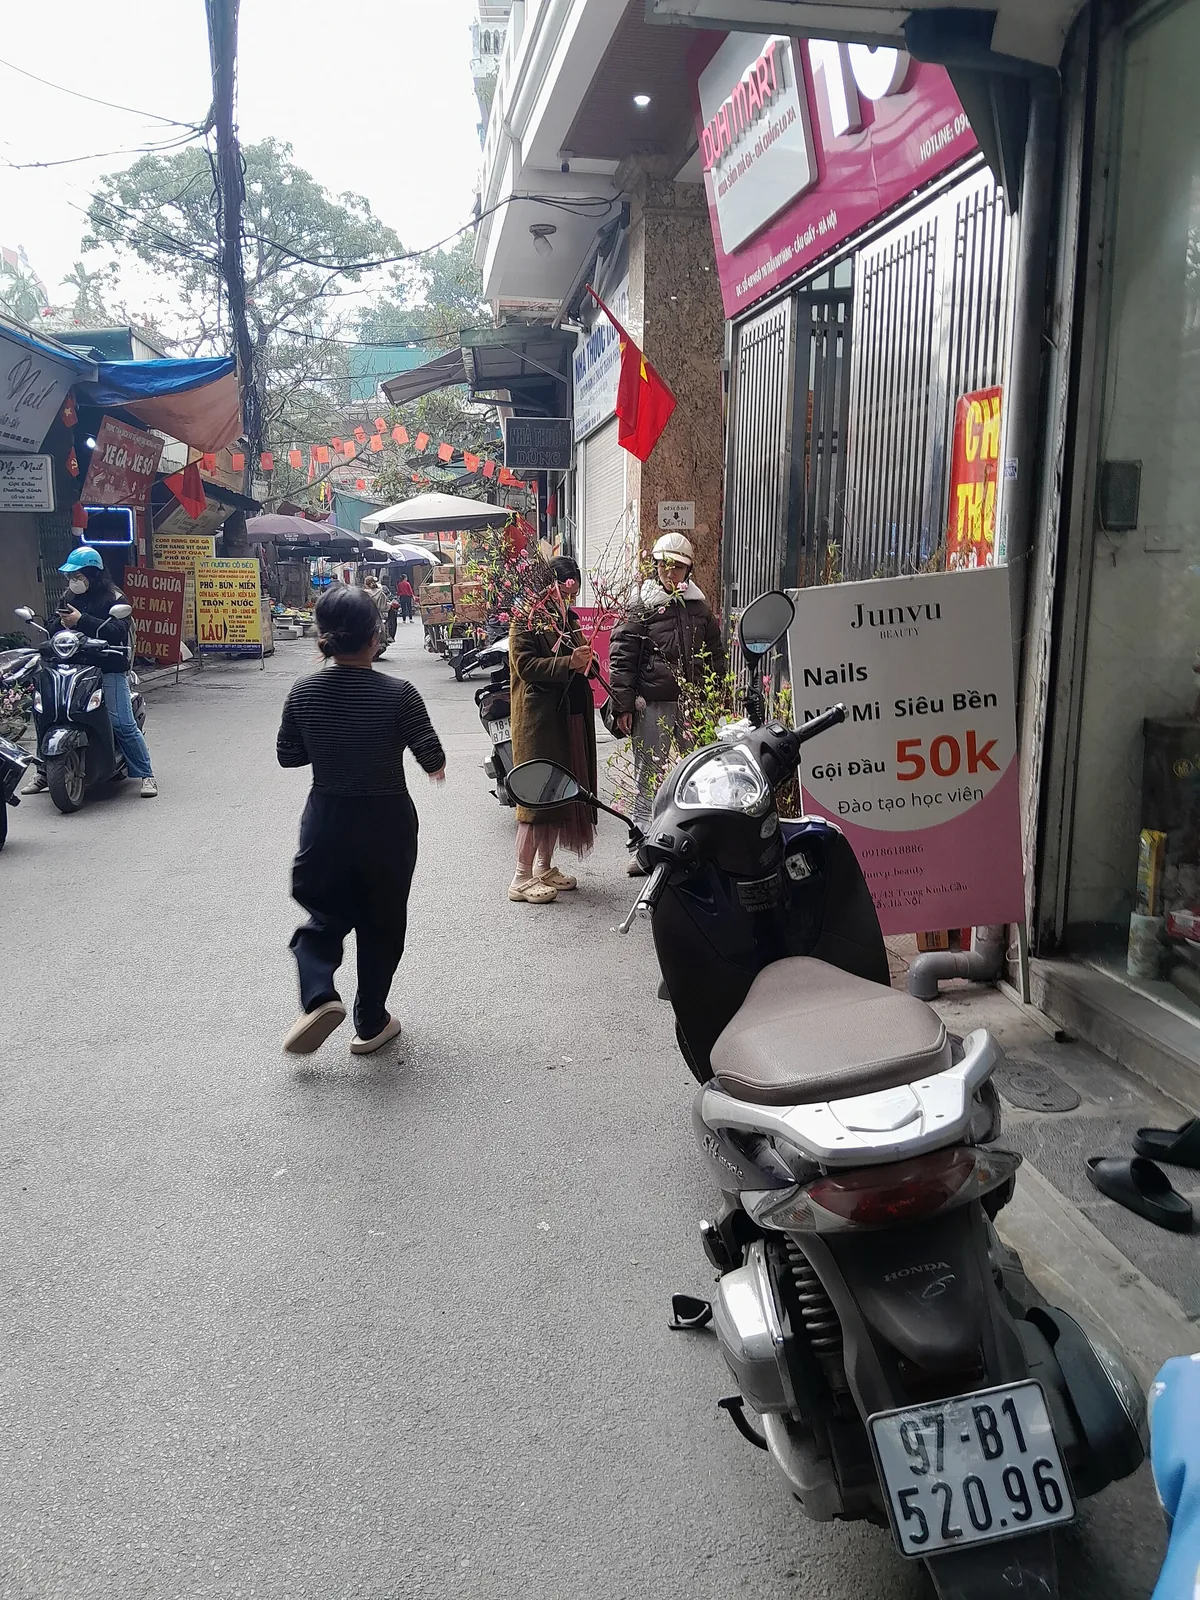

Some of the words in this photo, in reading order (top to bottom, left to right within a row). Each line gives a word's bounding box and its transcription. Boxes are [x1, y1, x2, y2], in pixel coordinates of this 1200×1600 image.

[732, 40, 778, 134] MART
[920, 124, 954, 161] HOTLINE:
[8, 354, 58, 412] Nail
[102, 444, 117, 465] XE
[116, 448, 128, 468] GA
[131, 453, 144, 473] XE
[142, 452, 156, 476] SỐ
[127, 570, 148, 588] SỬA
[152, 576, 182, 592] CHỮA
[200, 579, 214, 588] PHỞ
[219, 580, 234, 589] BÚN
[238, 579, 256, 590] MIẾN
[132, 596, 146, 610] XE
[149, 597, 174, 614] MÁY
[202, 598, 224, 608] TRỘN
[850, 602, 943, 628] Junvu
[154, 618, 177, 636] DẦU
[201, 614, 222, 640] LẨU
[880, 627, 920, 640] BEAUTY
[137, 636, 152, 654] ỬA
[156, 642, 169, 656] XE
[803, 662, 868, 687] Nails
[852, 702, 880, 722] Mi
[894, 696, 944, 717] Siêu
[952, 690, 998, 710] Bền
[812, 762, 842, 782] Gội
[848, 759, 886, 776] Đầu
[896, 730, 1000, 781] 50k
[838, 798, 872, 814] Đào
[878, 796, 906, 812] tạo
[912, 792, 943, 808] học
[948, 786, 984, 802] viên
[897, 888, 924, 897] Trung
[905, 896, 922, 907] Nội
[884, 1262, 952, 1282] HONDA
[900, 1396, 1028, 1476] 97-B1
[898, 1457, 1064, 1544] 520.96
